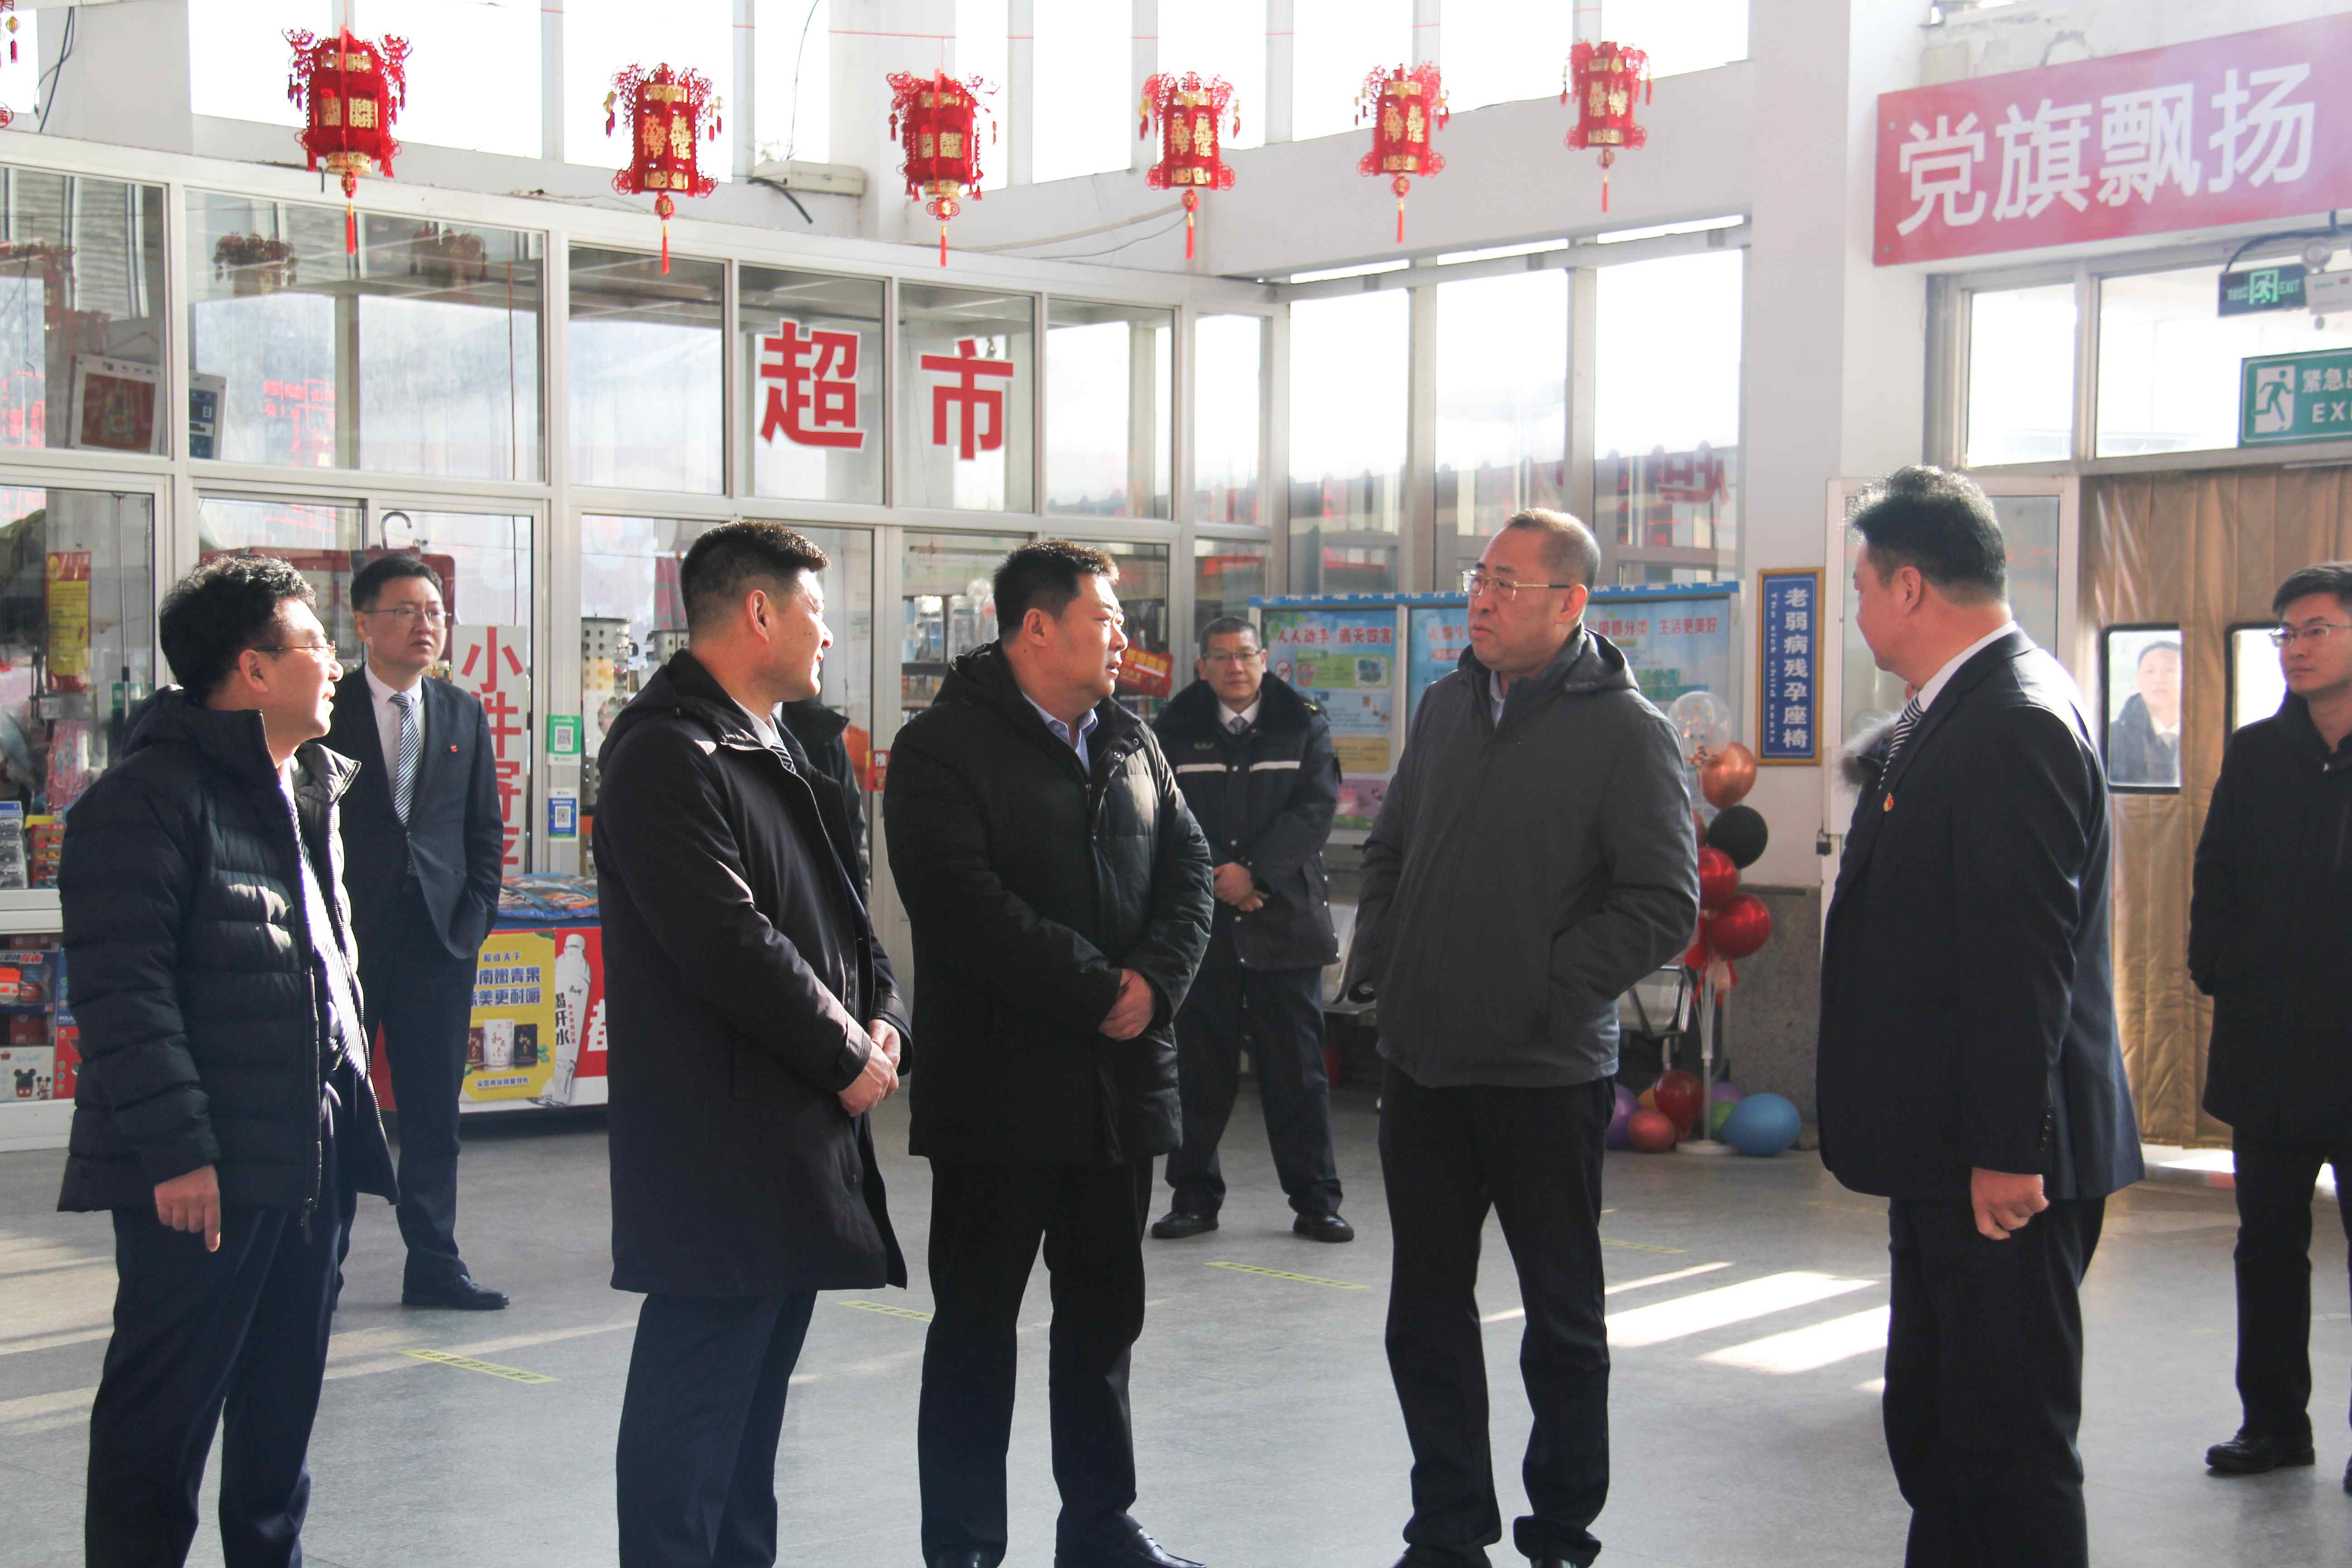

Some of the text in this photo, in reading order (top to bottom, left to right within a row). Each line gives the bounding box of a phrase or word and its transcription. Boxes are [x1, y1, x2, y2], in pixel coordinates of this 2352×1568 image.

[1896, 63, 2316, 237] 党旗飘扬
[2278, 279, 2301, 295] EXIT
[760, 319, 1014, 461] 超市
[1659, 616, 1718, 636] 生活更美好
[1783, 588, 1809, 749] 老弱病残孕座椅
[875, 753, 887, 767] 推
[476, 966, 541, 985] 南嫩青果
